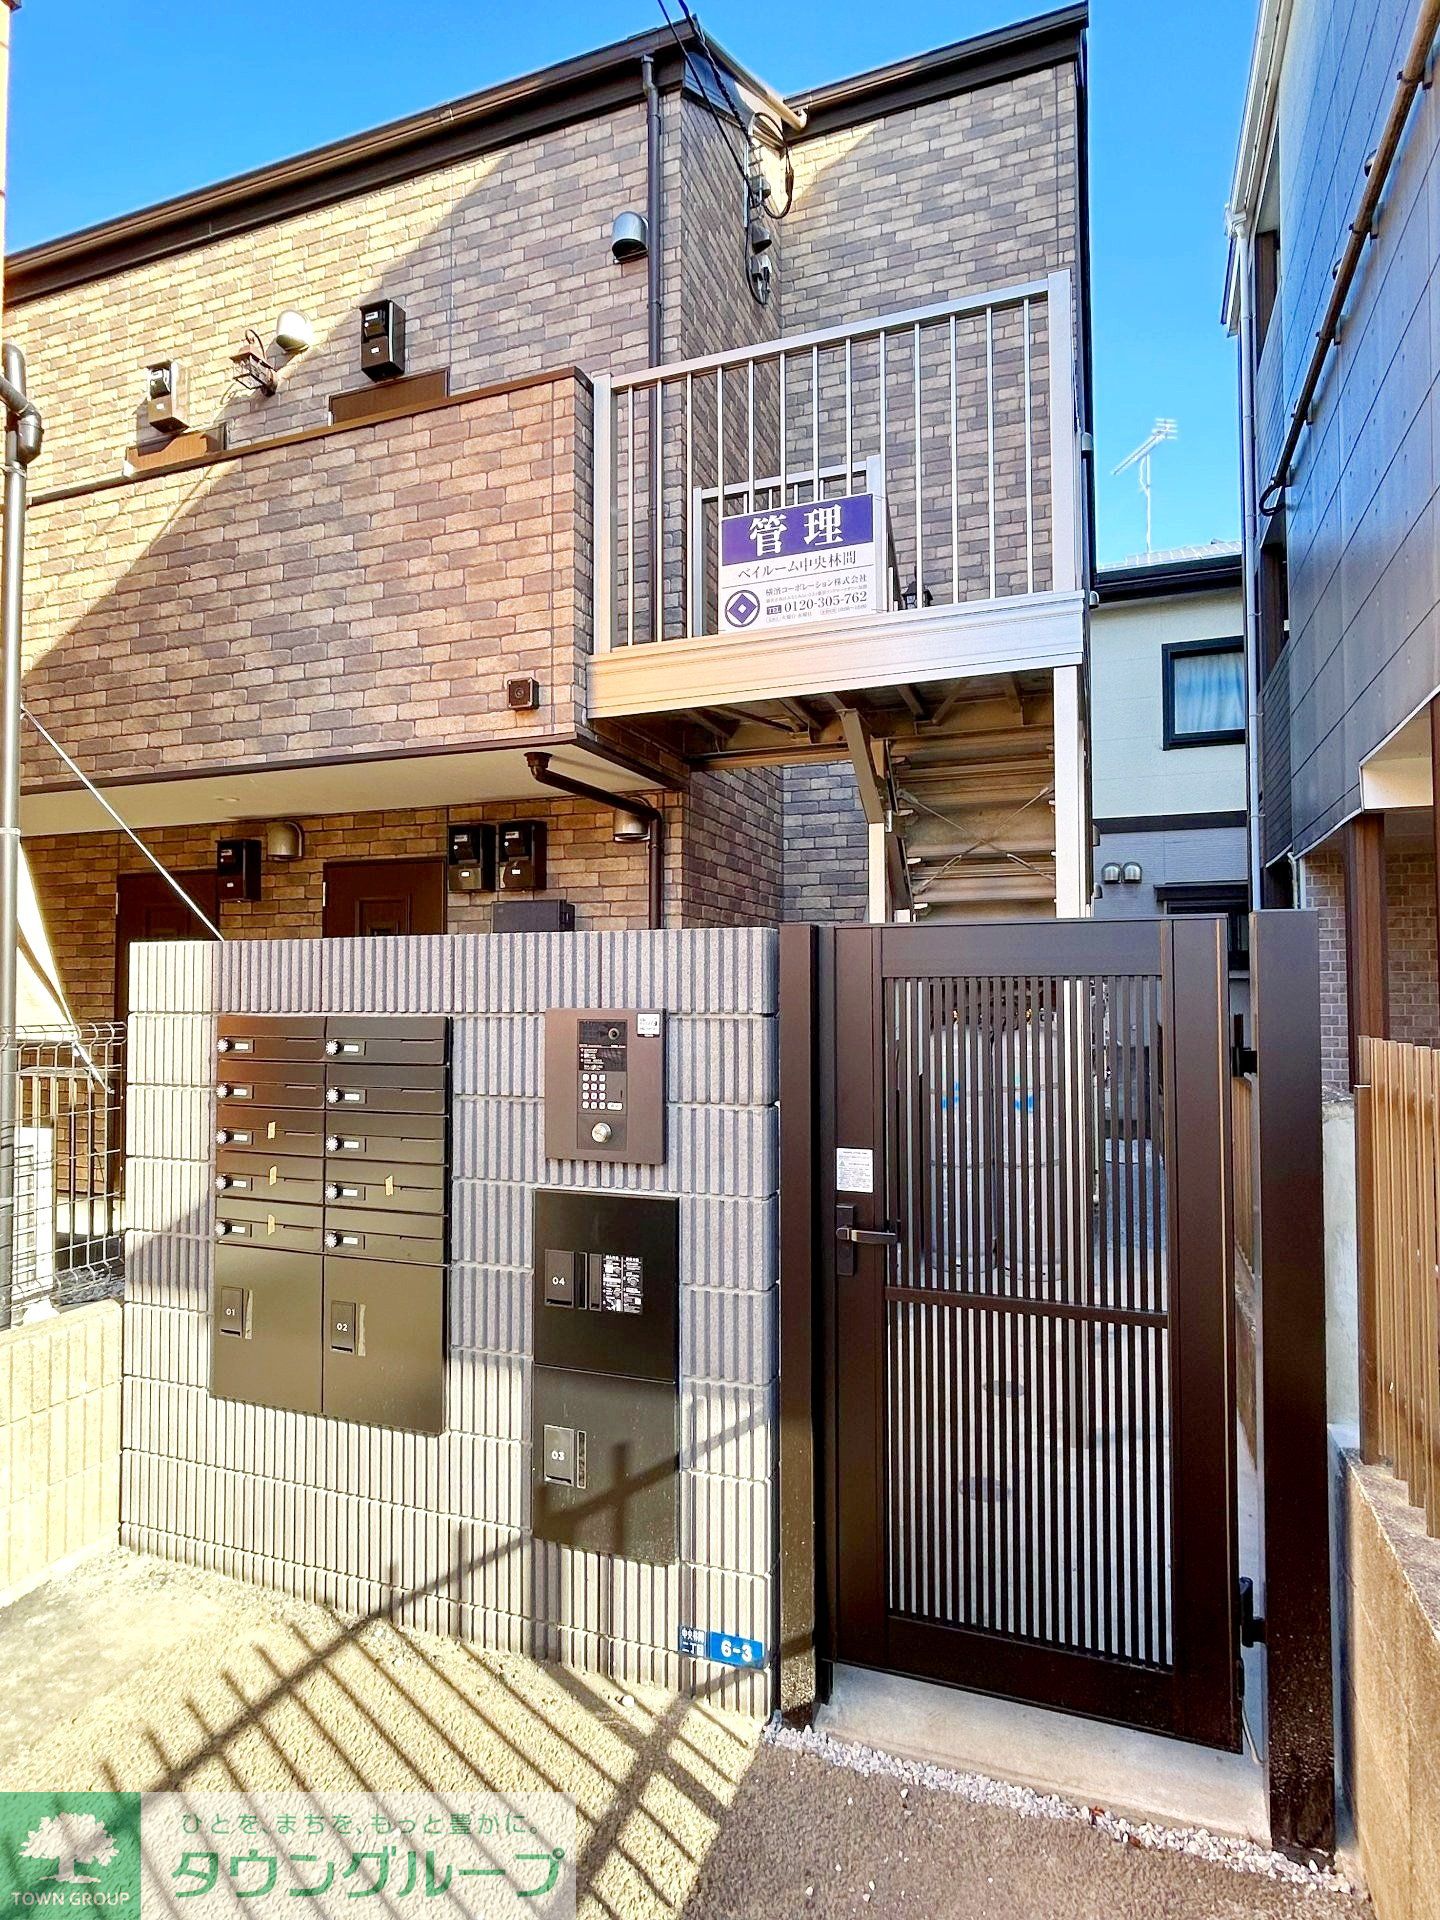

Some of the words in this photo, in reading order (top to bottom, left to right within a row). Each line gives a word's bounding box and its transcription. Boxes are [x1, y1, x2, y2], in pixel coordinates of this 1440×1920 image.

[749, 504, 844, 556] 管理
[738, 550, 856, 578] ベイルーム中央林間
[784, 591, 868, 613] 0120-305-762
[552, 1277, 565, 1286] 04
[226, 1308, 235, 1316] 01
[336, 1322, 348, 1332] 02
[681, 1642, 704, 1656] 二丁目
[721, 1640, 753, 1663] 6-3
